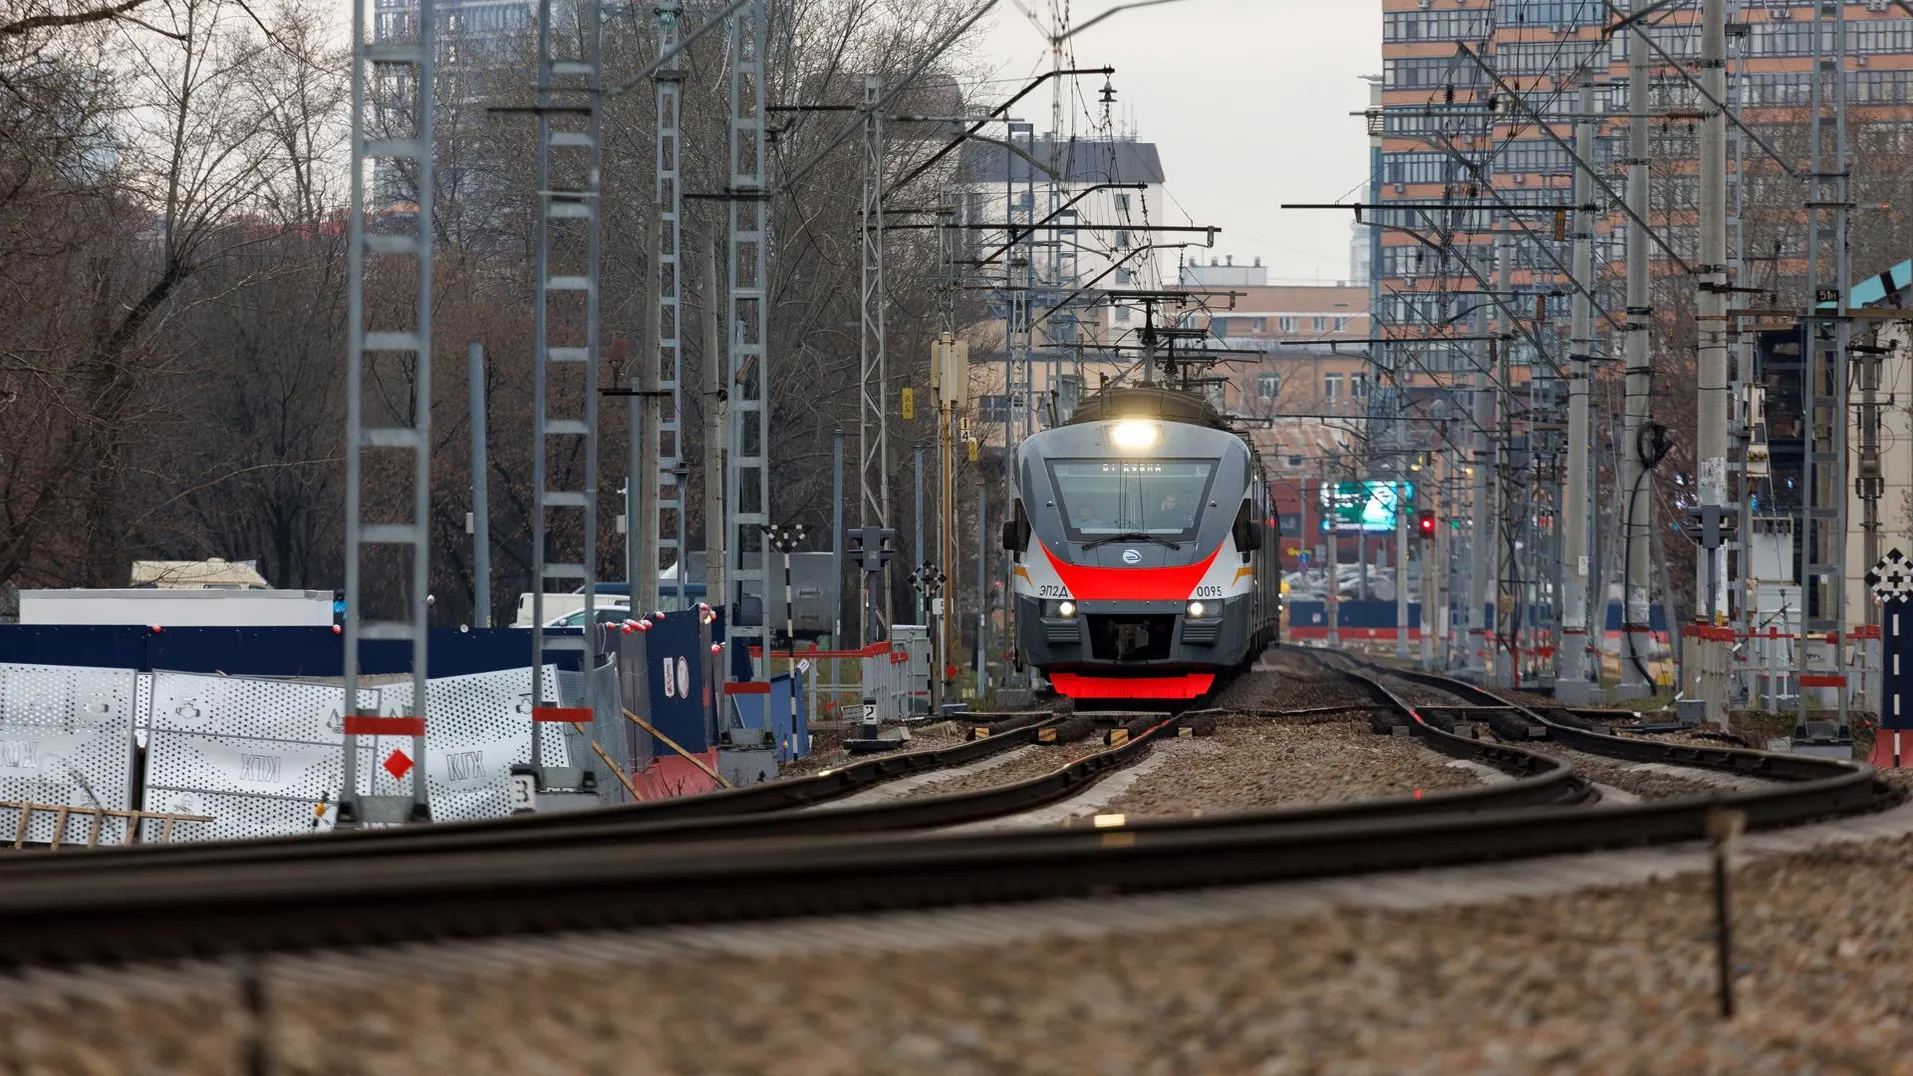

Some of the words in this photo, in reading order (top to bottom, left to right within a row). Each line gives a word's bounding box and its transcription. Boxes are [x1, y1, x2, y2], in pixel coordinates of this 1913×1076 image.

[962, 431, 969, 441] 4
[1039, 585, 1069, 598] ЭП2Д
[1197, 585, 1223, 598] 0095
[865, 705, 875, 720] 2
[514, 779, 529, 803] 3
